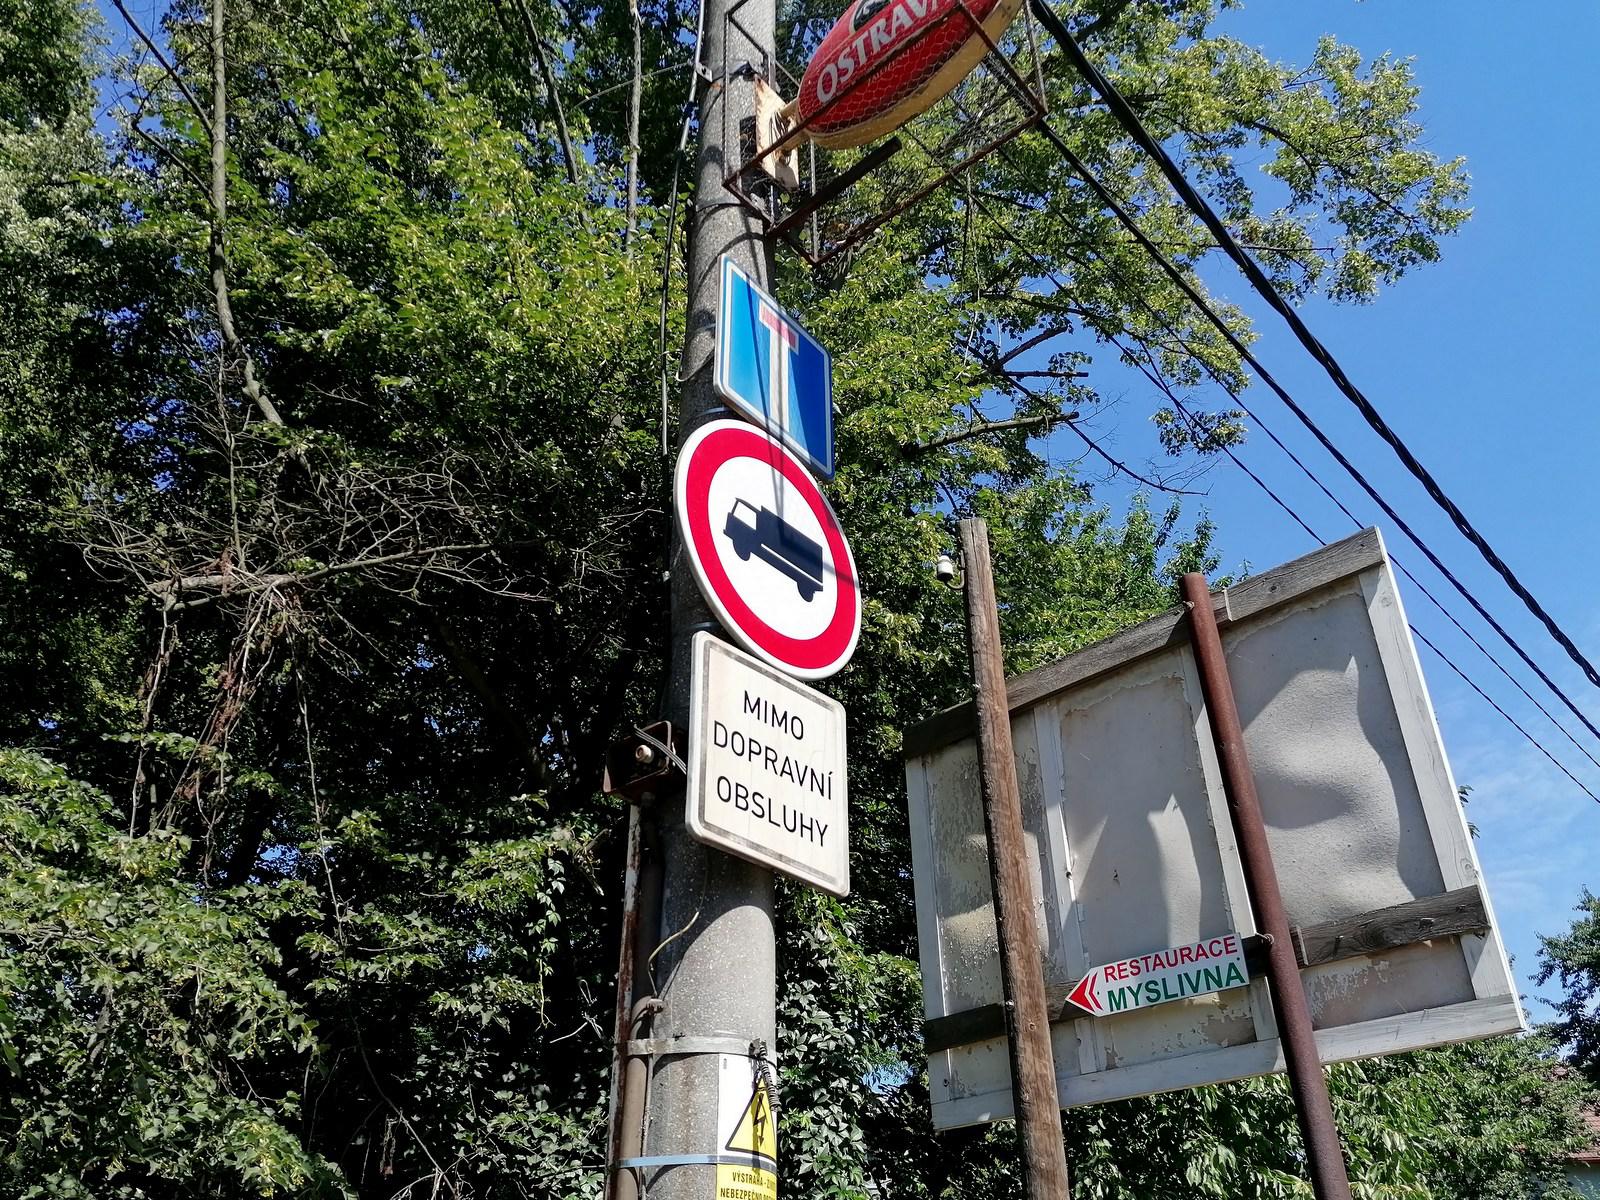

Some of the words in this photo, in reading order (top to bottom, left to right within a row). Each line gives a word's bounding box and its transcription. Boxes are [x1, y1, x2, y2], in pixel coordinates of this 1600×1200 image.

[743, 690, 804, 740] MIMO
[713, 720, 834, 800] DOPRAVNÍ
[716, 775, 828, 847] OBSLUHY
[1103, 936, 1238, 983] RESTAURACE
[1107, 962, 1246, 1012] MYSLIVNA
